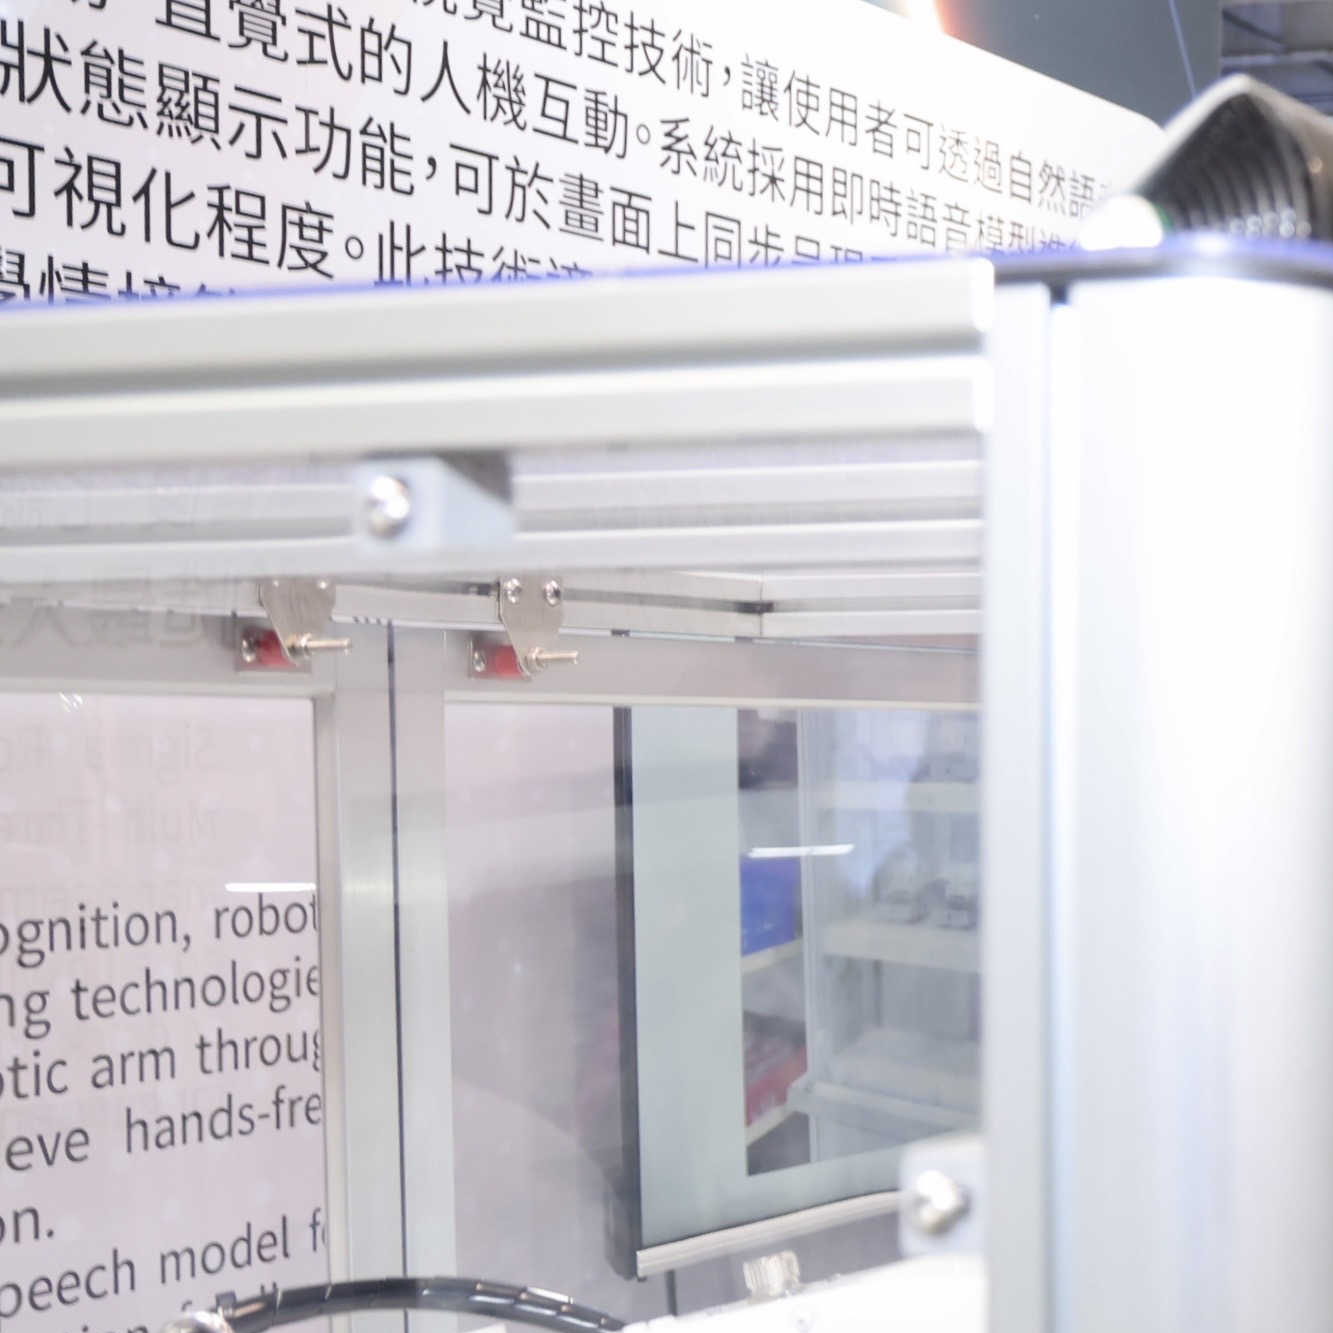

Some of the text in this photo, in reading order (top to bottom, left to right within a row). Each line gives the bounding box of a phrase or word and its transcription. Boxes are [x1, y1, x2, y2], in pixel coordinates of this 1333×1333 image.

[0, 902, 192, 968] gnition,
[0, 1050, 69, 1100] tic
[90, 1045, 176, 1090] arm
[159, 1215, 289, 1287] model
